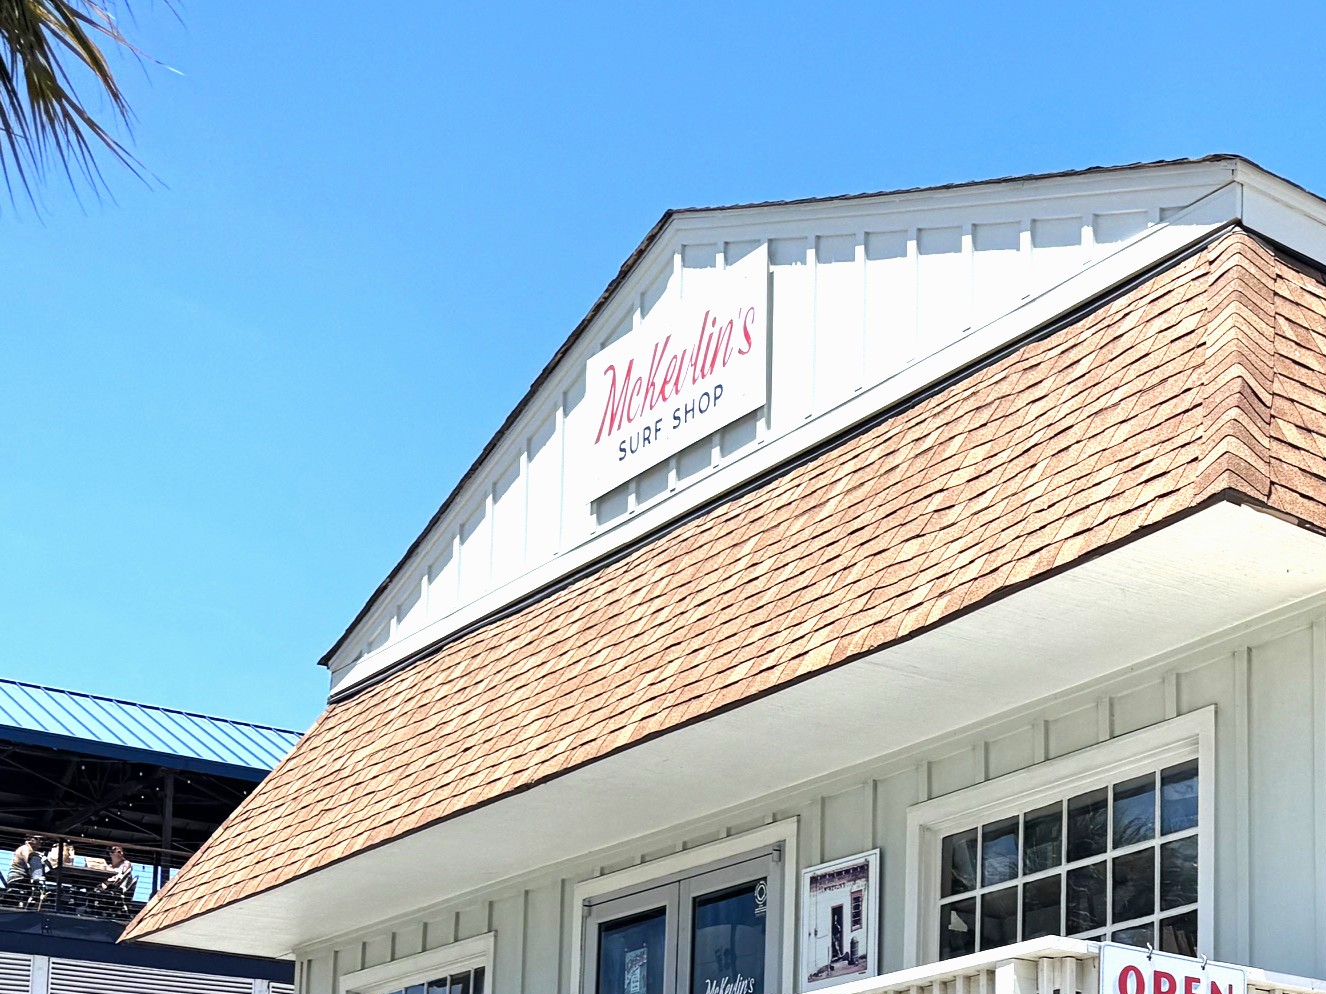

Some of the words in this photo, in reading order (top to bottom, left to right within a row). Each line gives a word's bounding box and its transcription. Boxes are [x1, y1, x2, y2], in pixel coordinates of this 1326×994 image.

[594, 306, 755, 445] McKevlin's
[618, 418, 663, 462] SURF
[672, 384, 724, 430] SHOP
